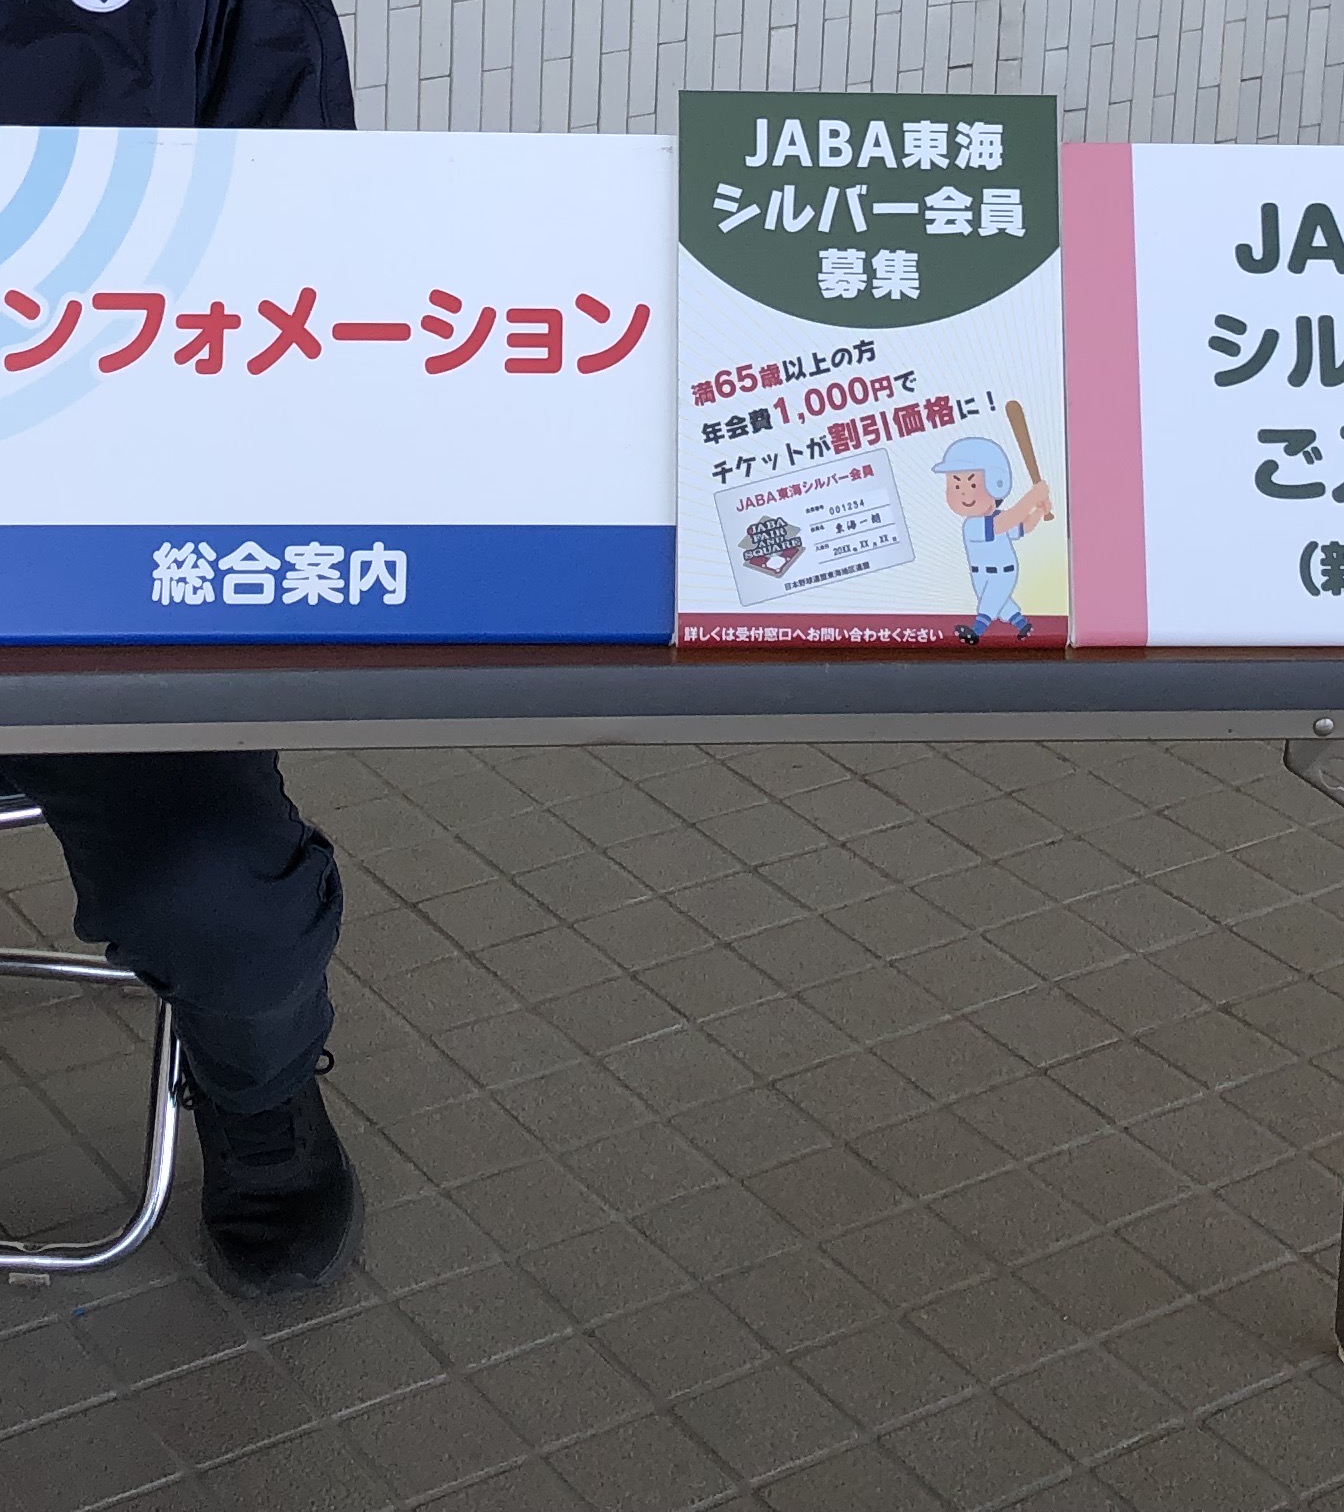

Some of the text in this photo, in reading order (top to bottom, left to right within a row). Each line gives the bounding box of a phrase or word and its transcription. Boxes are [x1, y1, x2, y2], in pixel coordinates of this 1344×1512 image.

[744, 118, 1004, 171] JABA東海
[712, 183, 1026, 237] シルバー会員
[817, 248, 921, 300] 募集
[691, 339, 876, 407] 満65歳以上の方
[701, 370, 918, 445] 年会費1,000円で
[736, 464, 875, 513] JABA東海シルバー会員
[150, 540, 409, 607] 総合案内
[684, 625, 944, 643] 詳しくは受付窓口へお問い合わせください
